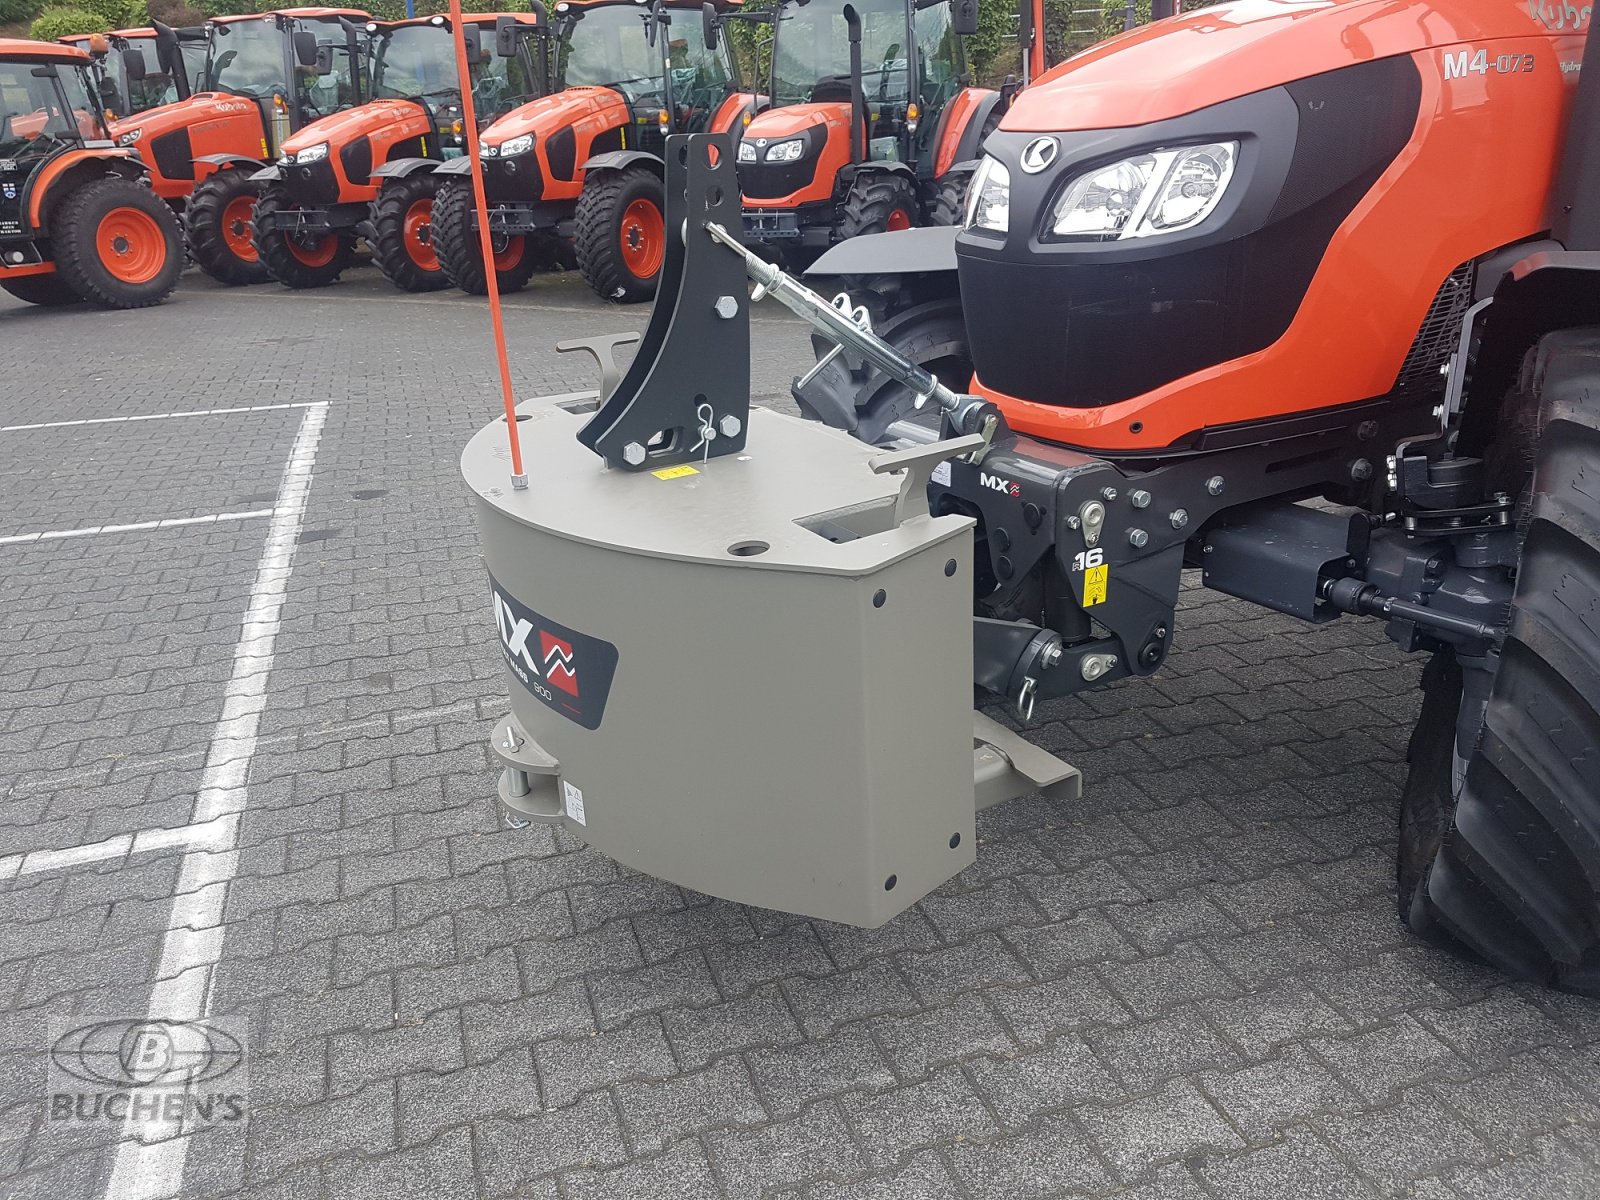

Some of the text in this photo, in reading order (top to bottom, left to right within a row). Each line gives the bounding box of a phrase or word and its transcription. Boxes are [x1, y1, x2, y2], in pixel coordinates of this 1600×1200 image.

[1444, 49, 1534, 80] M4-073
[980, 472, 1009, 494] MX
[533, 681, 552, 701] 900
